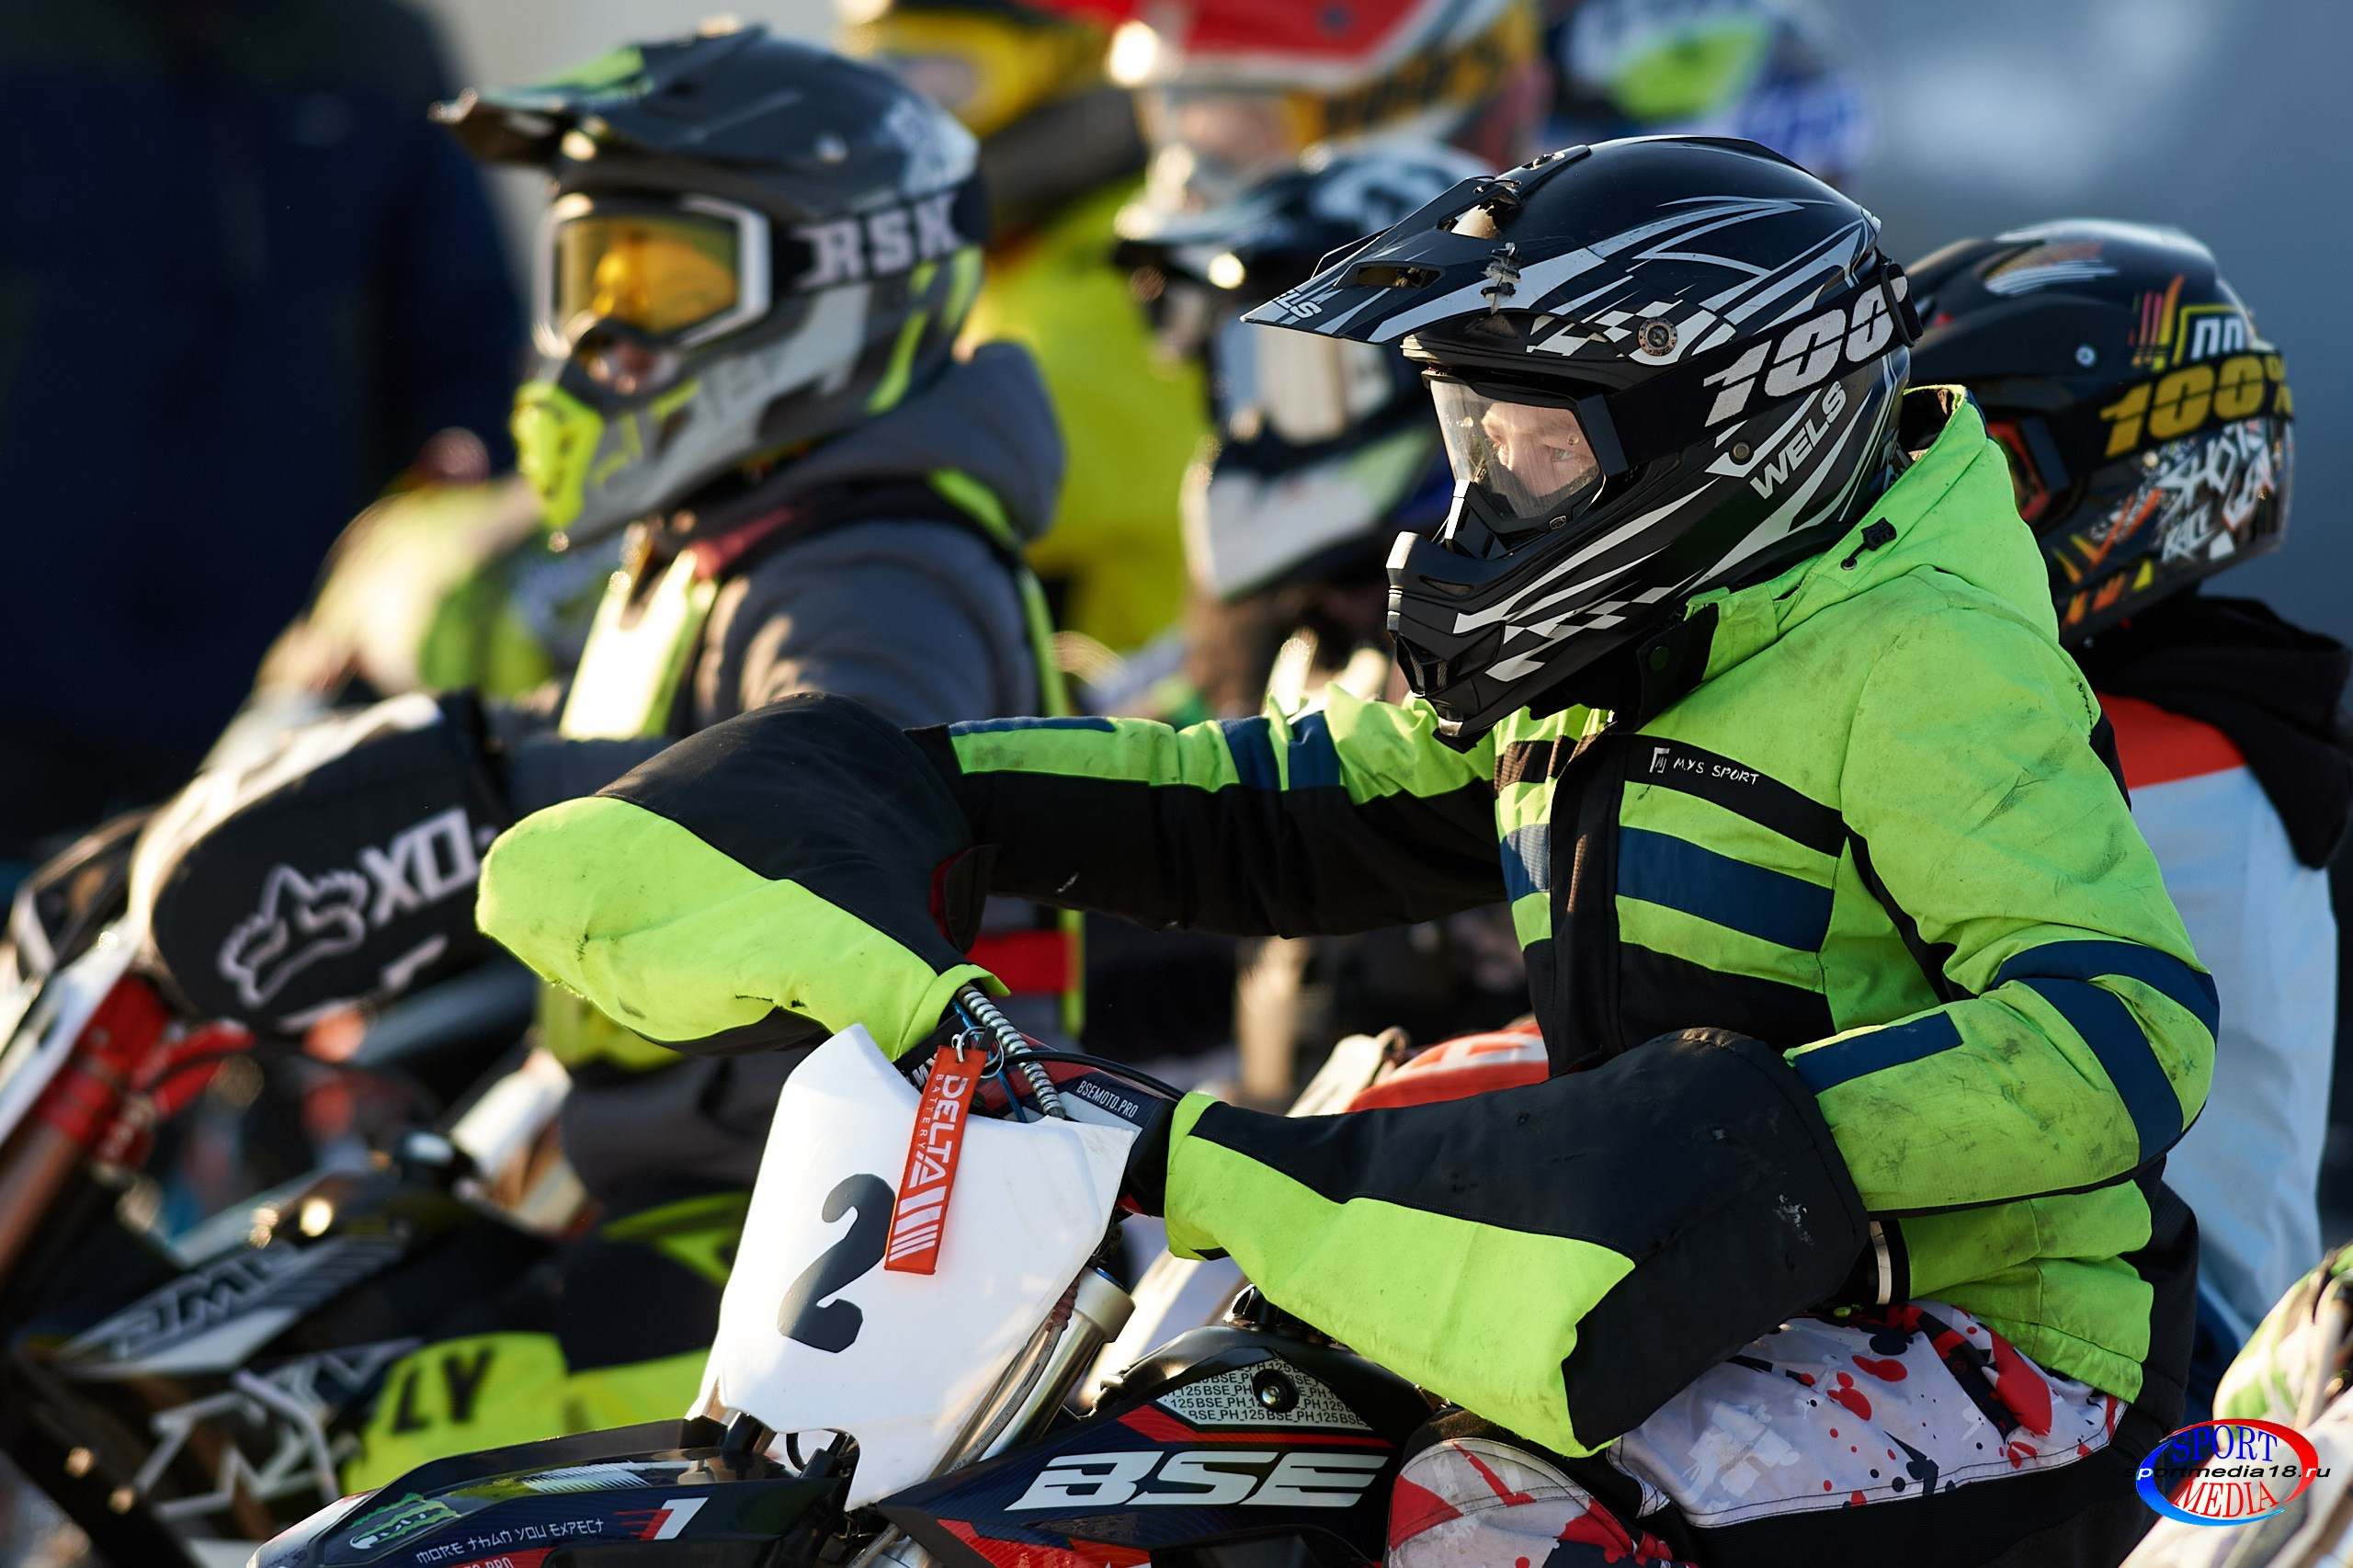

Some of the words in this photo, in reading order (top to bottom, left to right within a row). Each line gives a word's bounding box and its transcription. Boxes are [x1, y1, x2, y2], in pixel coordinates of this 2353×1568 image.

[1749, 381, 1847, 500] WELS
[1711, 765, 1760, 785] SPORT
[908, 1074, 969, 1188] DELTA
[916, 1073, 945, 1148] BATTERY
[1076, 1080, 1139, 1119] BSEMOTO.PRO
[777, 1173, 896, 1353] 2
[1004, 1450, 1389, 1511] BSE
[415, 1542, 465, 1564] MORE
[515, 1523, 547, 1541] YOU
